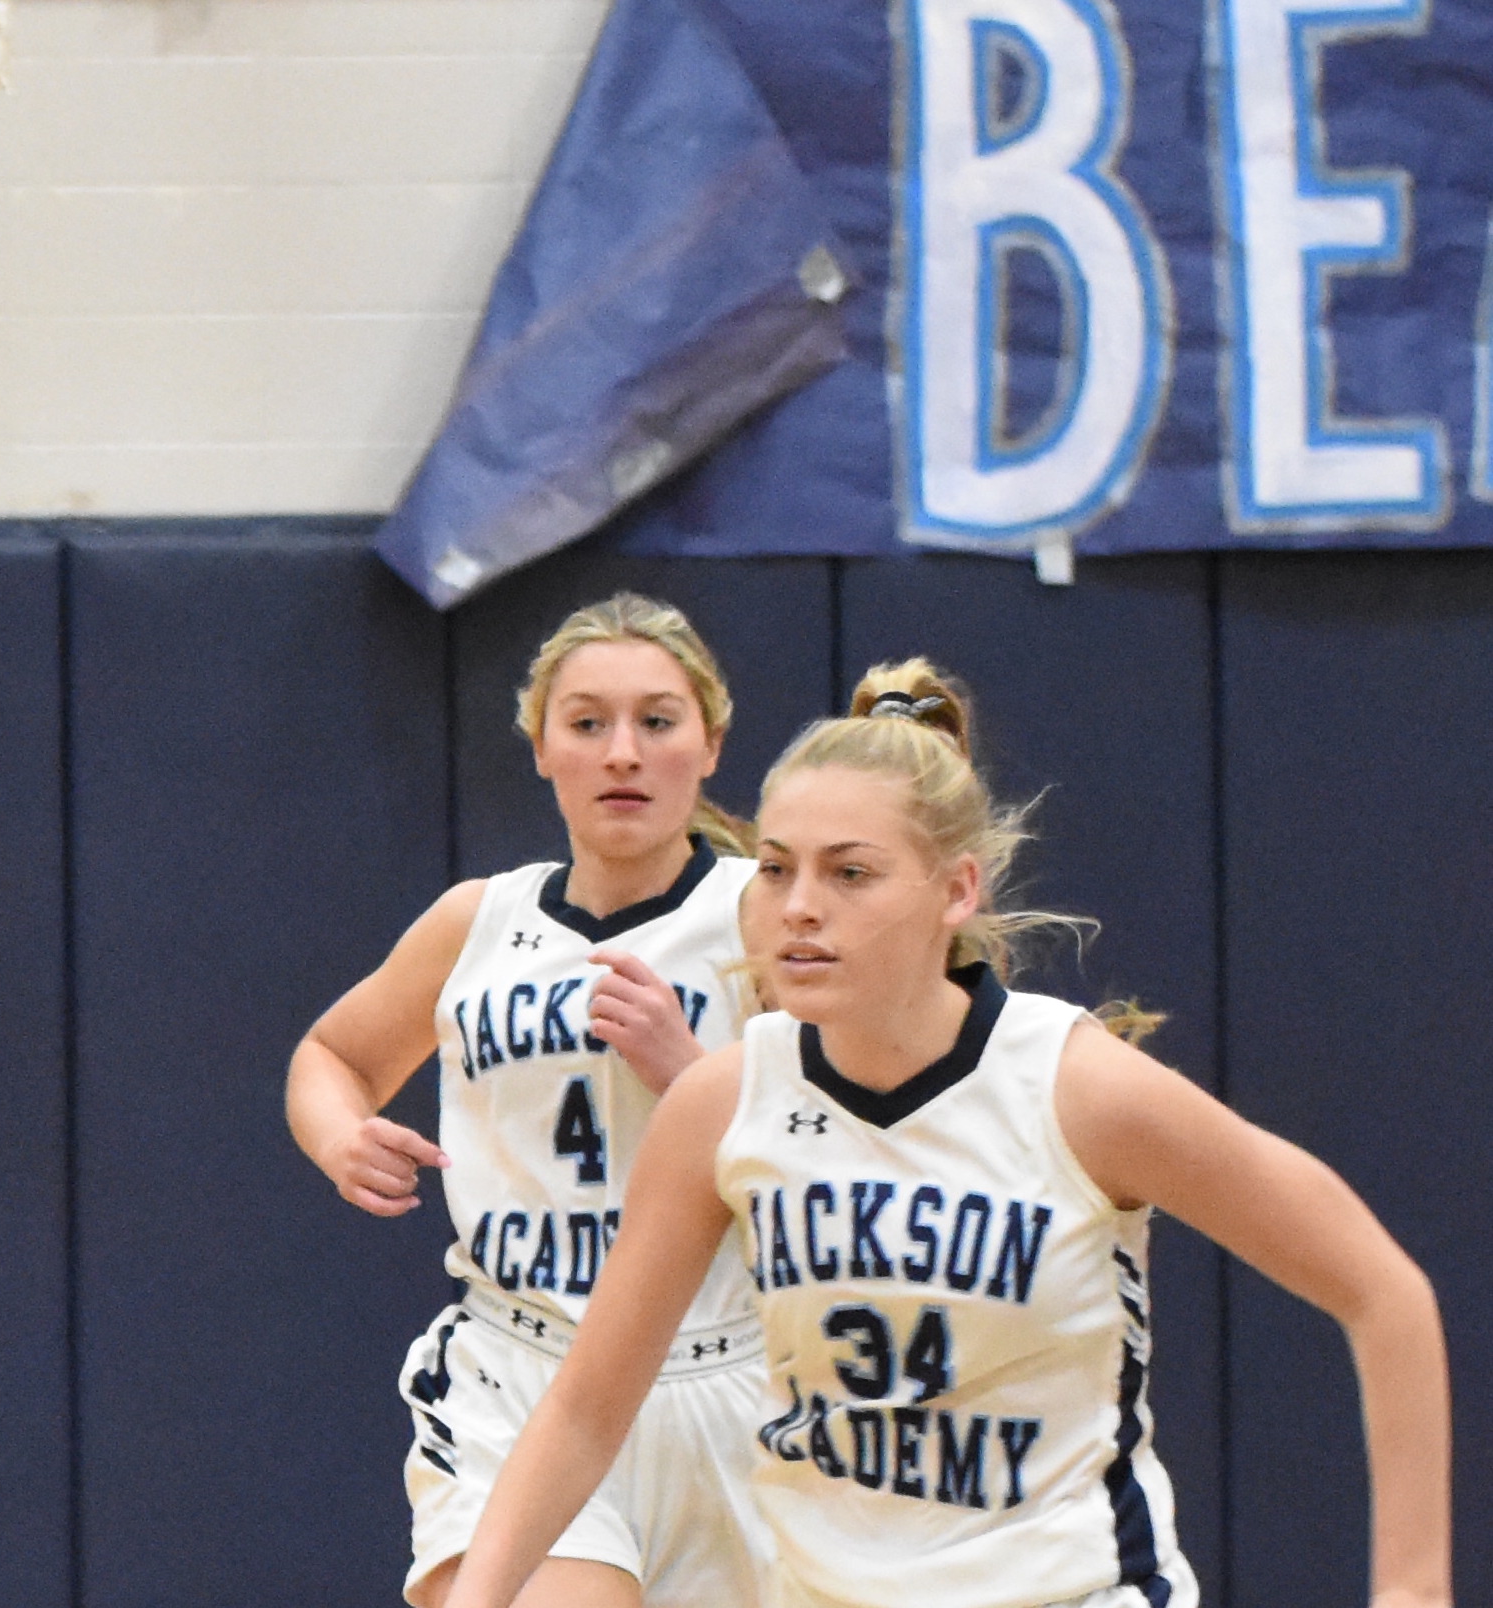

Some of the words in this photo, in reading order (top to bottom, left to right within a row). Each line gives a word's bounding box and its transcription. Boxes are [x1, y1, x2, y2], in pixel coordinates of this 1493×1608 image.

[889, 0, 1493, 545] BE
[553, 1073, 608, 1187] 4
[820, 1301, 955, 1406] 34
